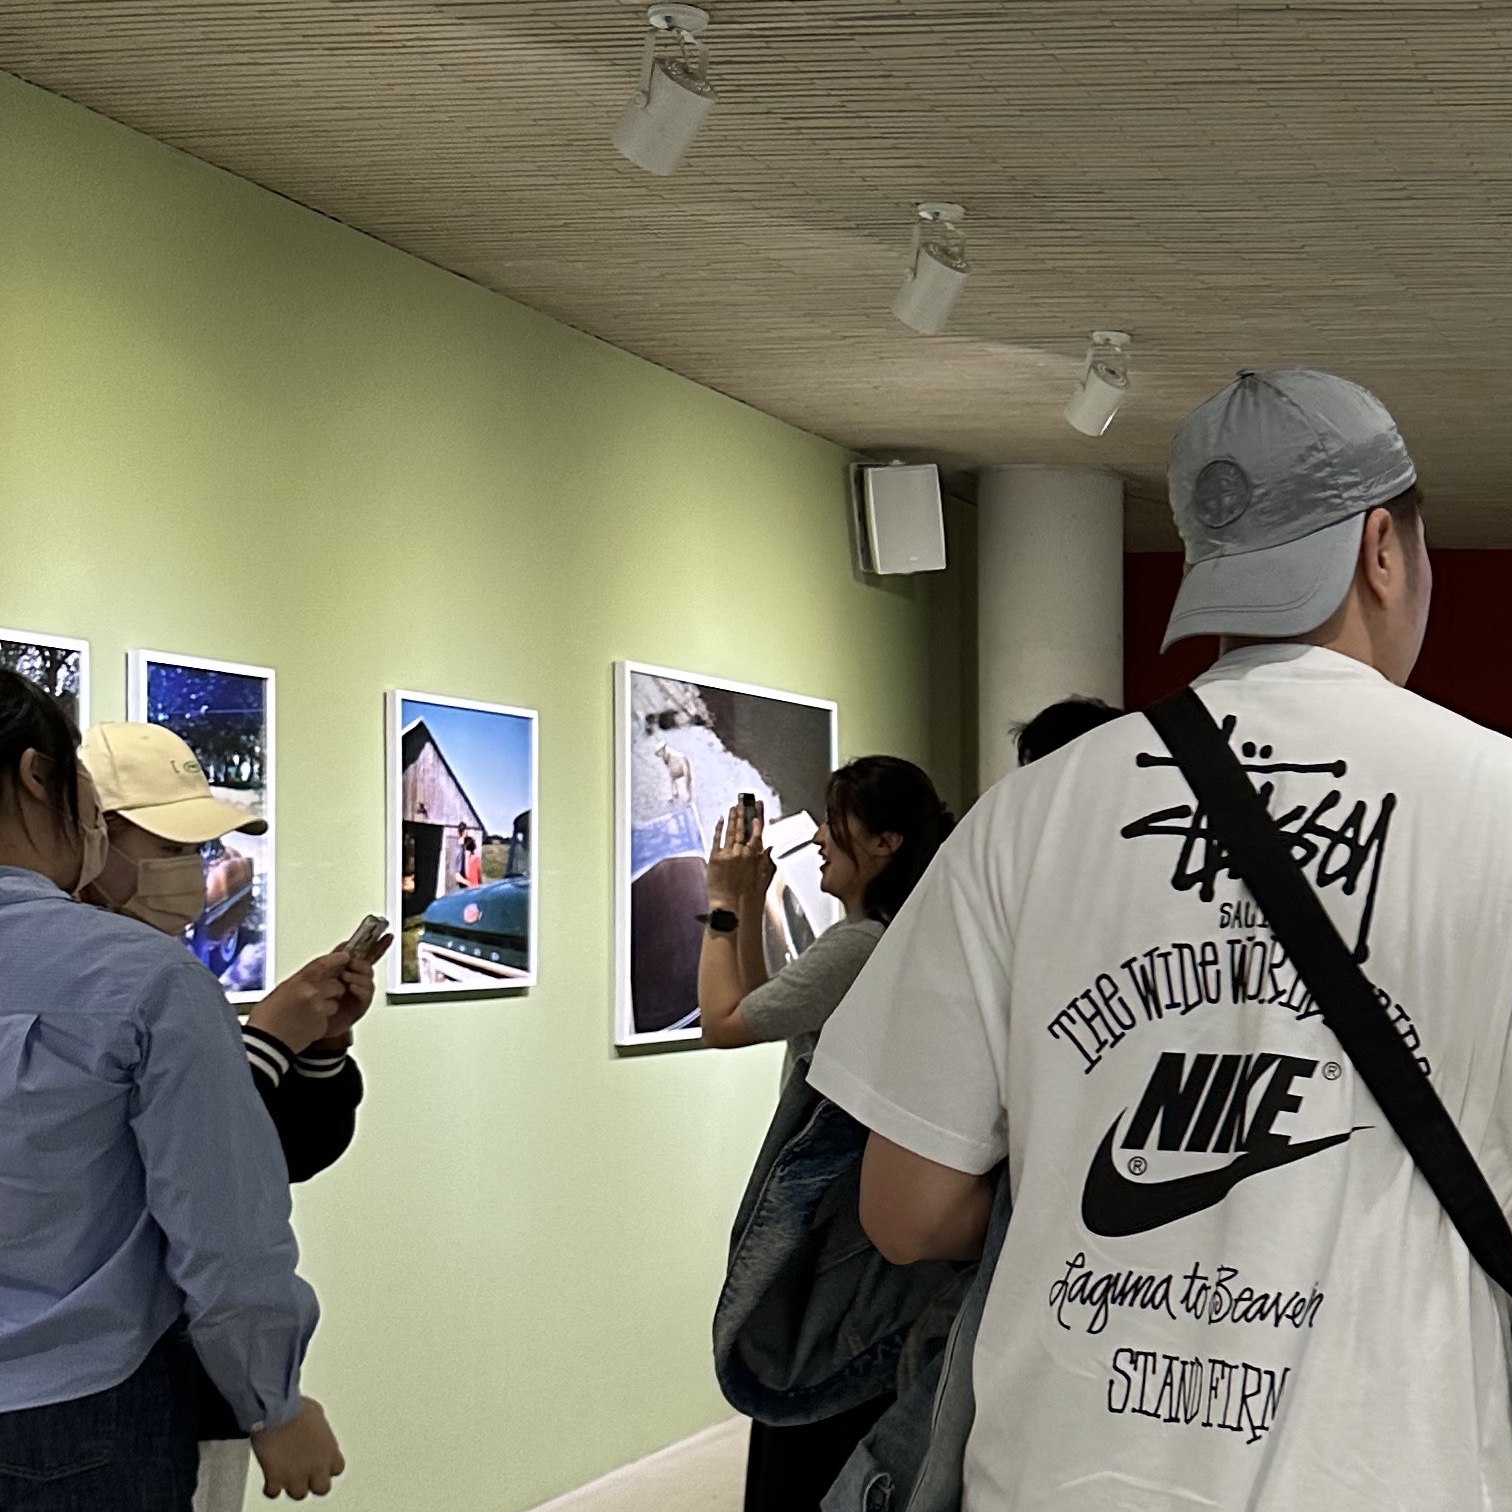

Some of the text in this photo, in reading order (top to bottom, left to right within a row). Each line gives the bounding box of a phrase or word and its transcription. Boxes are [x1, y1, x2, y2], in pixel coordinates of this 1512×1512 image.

[1120, 1052, 1319, 1153] NIKE
[1049, 1253, 1177, 1334] Laguna
[1180, 1261, 1211, 1320] to
